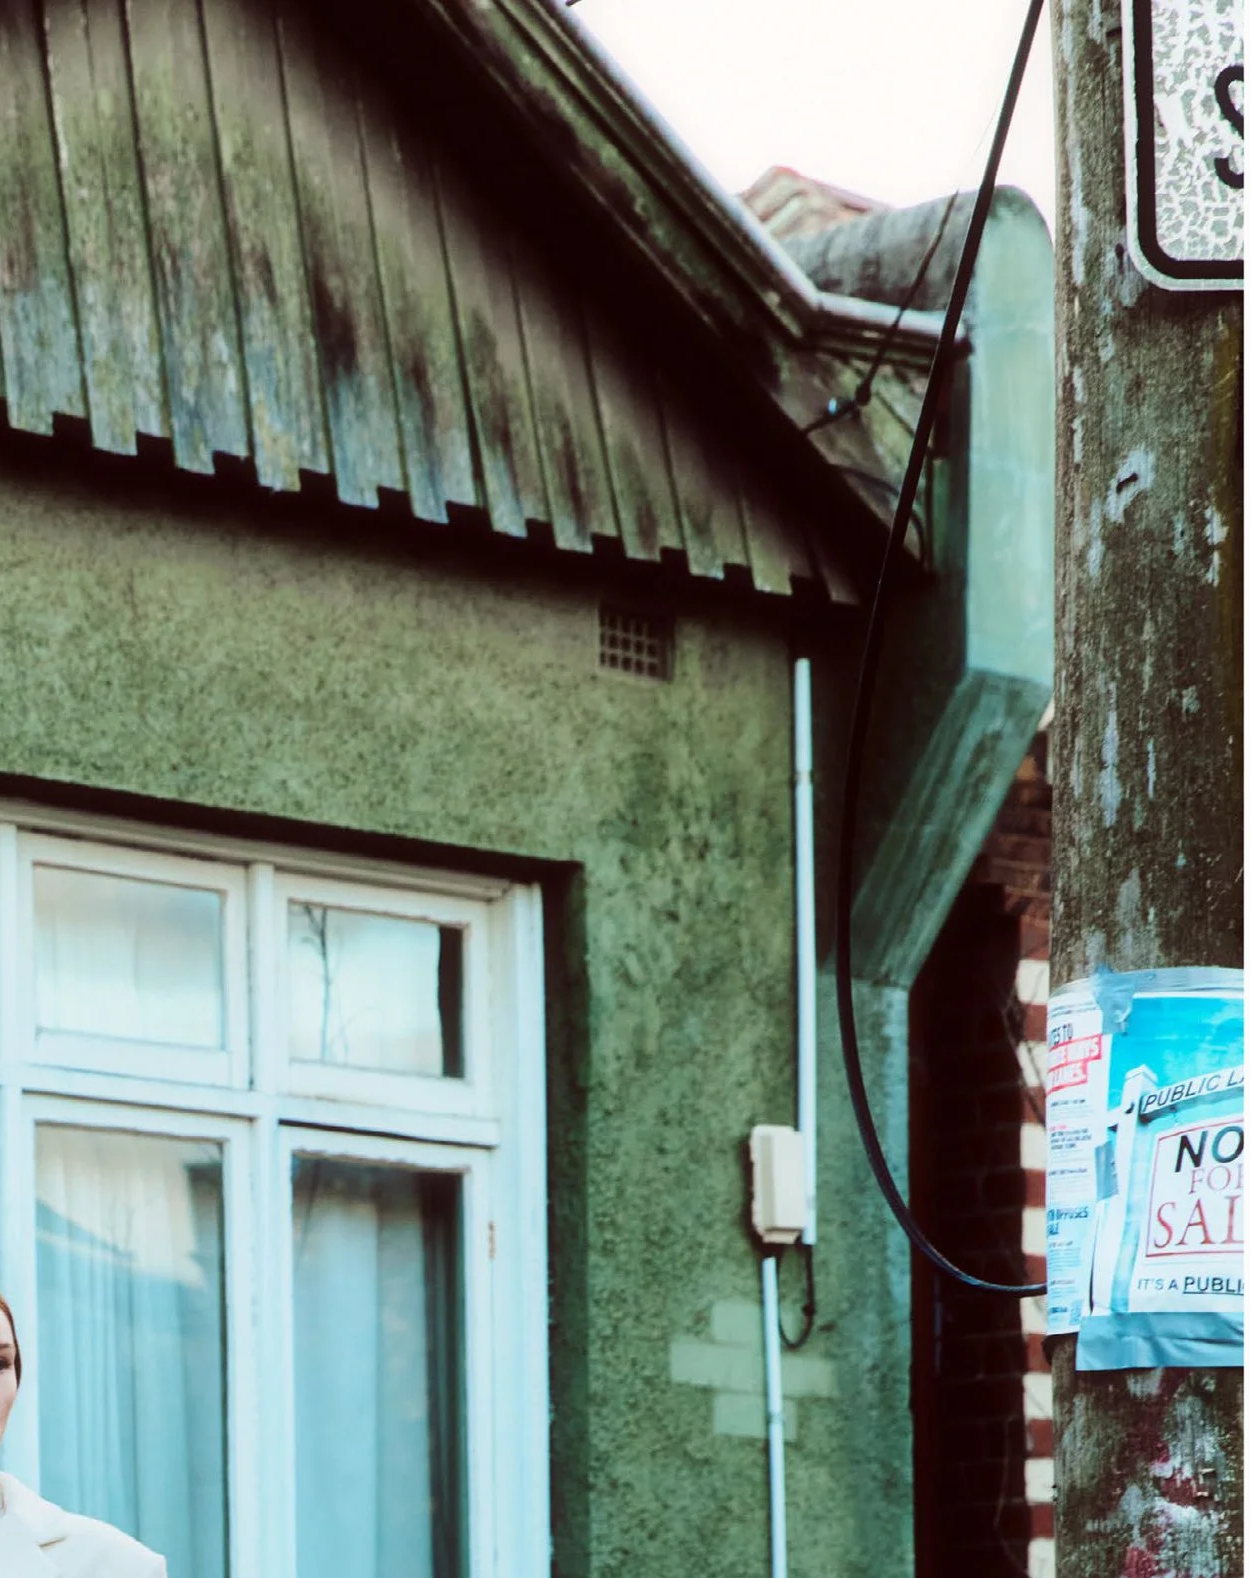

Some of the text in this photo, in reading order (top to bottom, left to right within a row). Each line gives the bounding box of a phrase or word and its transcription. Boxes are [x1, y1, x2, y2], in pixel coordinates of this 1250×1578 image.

[1142, 1070, 1244, 1113] PUBLIC L
[1174, 1125, 1244, 1173] NO
[1153, 1194, 1244, 1249] SAL
[1137, 1275, 1244, 1293] IT'S A PUBLI
